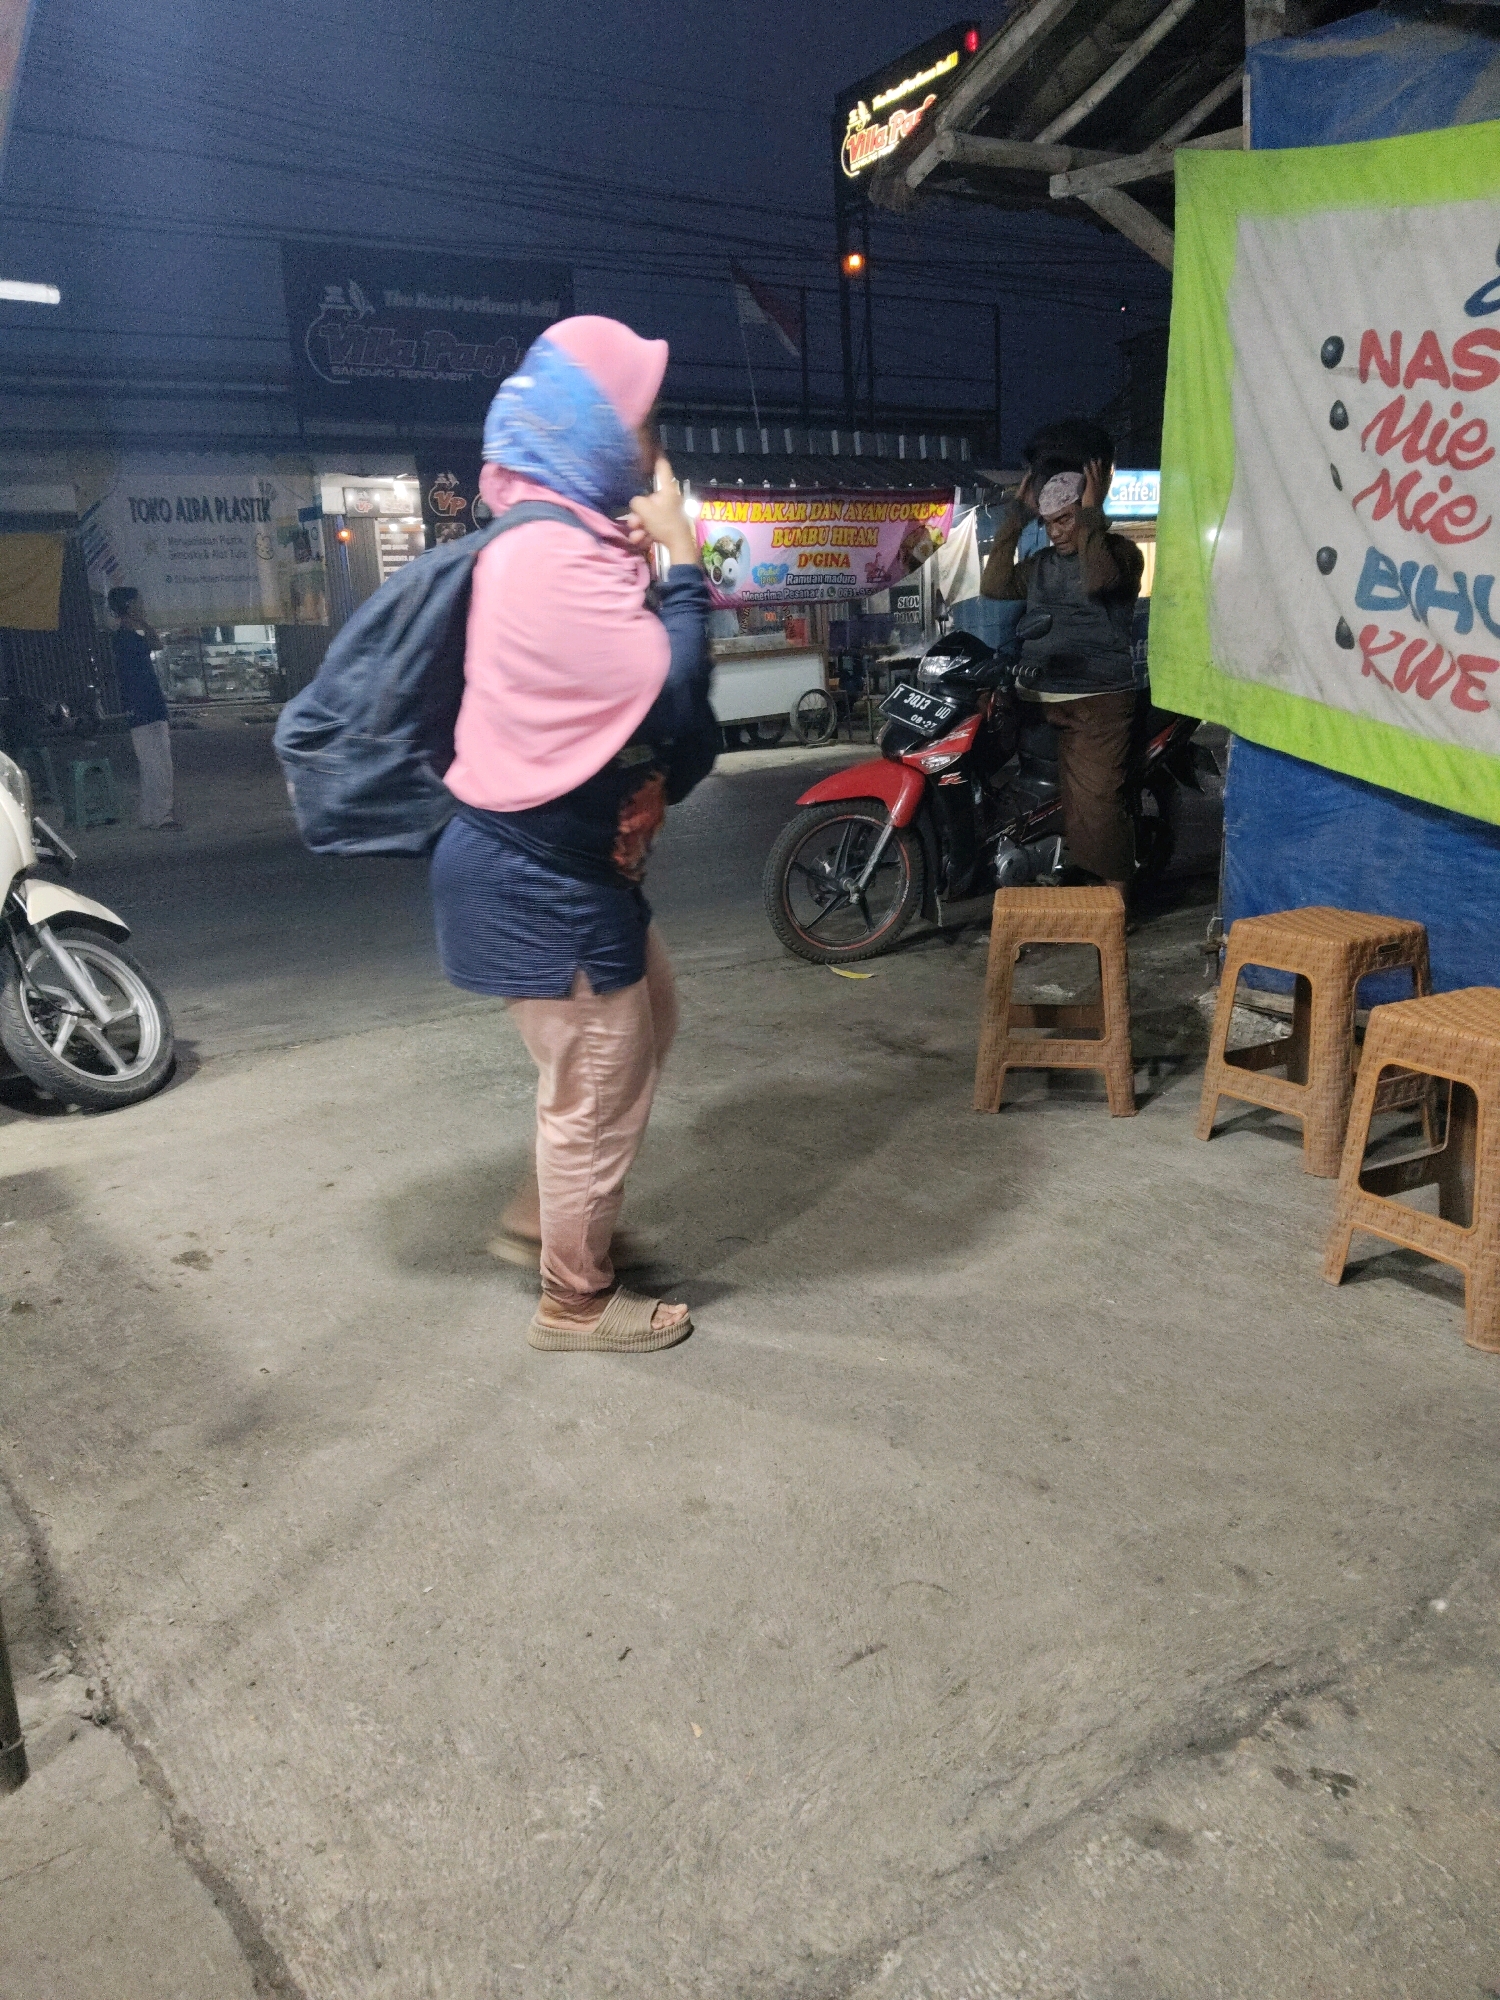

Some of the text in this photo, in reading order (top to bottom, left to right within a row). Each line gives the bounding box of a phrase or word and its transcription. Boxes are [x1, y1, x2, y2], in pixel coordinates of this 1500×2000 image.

[847, 123, 888, 164] Villa
[318, 323, 417, 368] Villa
[1361, 394, 1496, 470] Mie
[128, 496, 172, 523] TOKO
[214, 496, 272, 523] PLASTIK
[700, 501, 750, 522] AYAM
[750, 501, 807, 523] BAKAR
[810, 501, 842, 521] DAN
[842, 501, 888, 521] AYAM
[1352, 468, 1493, 544] Mie
[772, 526, 880, 548] BUMBU HITAM
[797, 551, 851, 569] D'GINA
[786, 573, 857, 585] Ramuan madura
[893, 687, 951, 719] T 3013 UD
